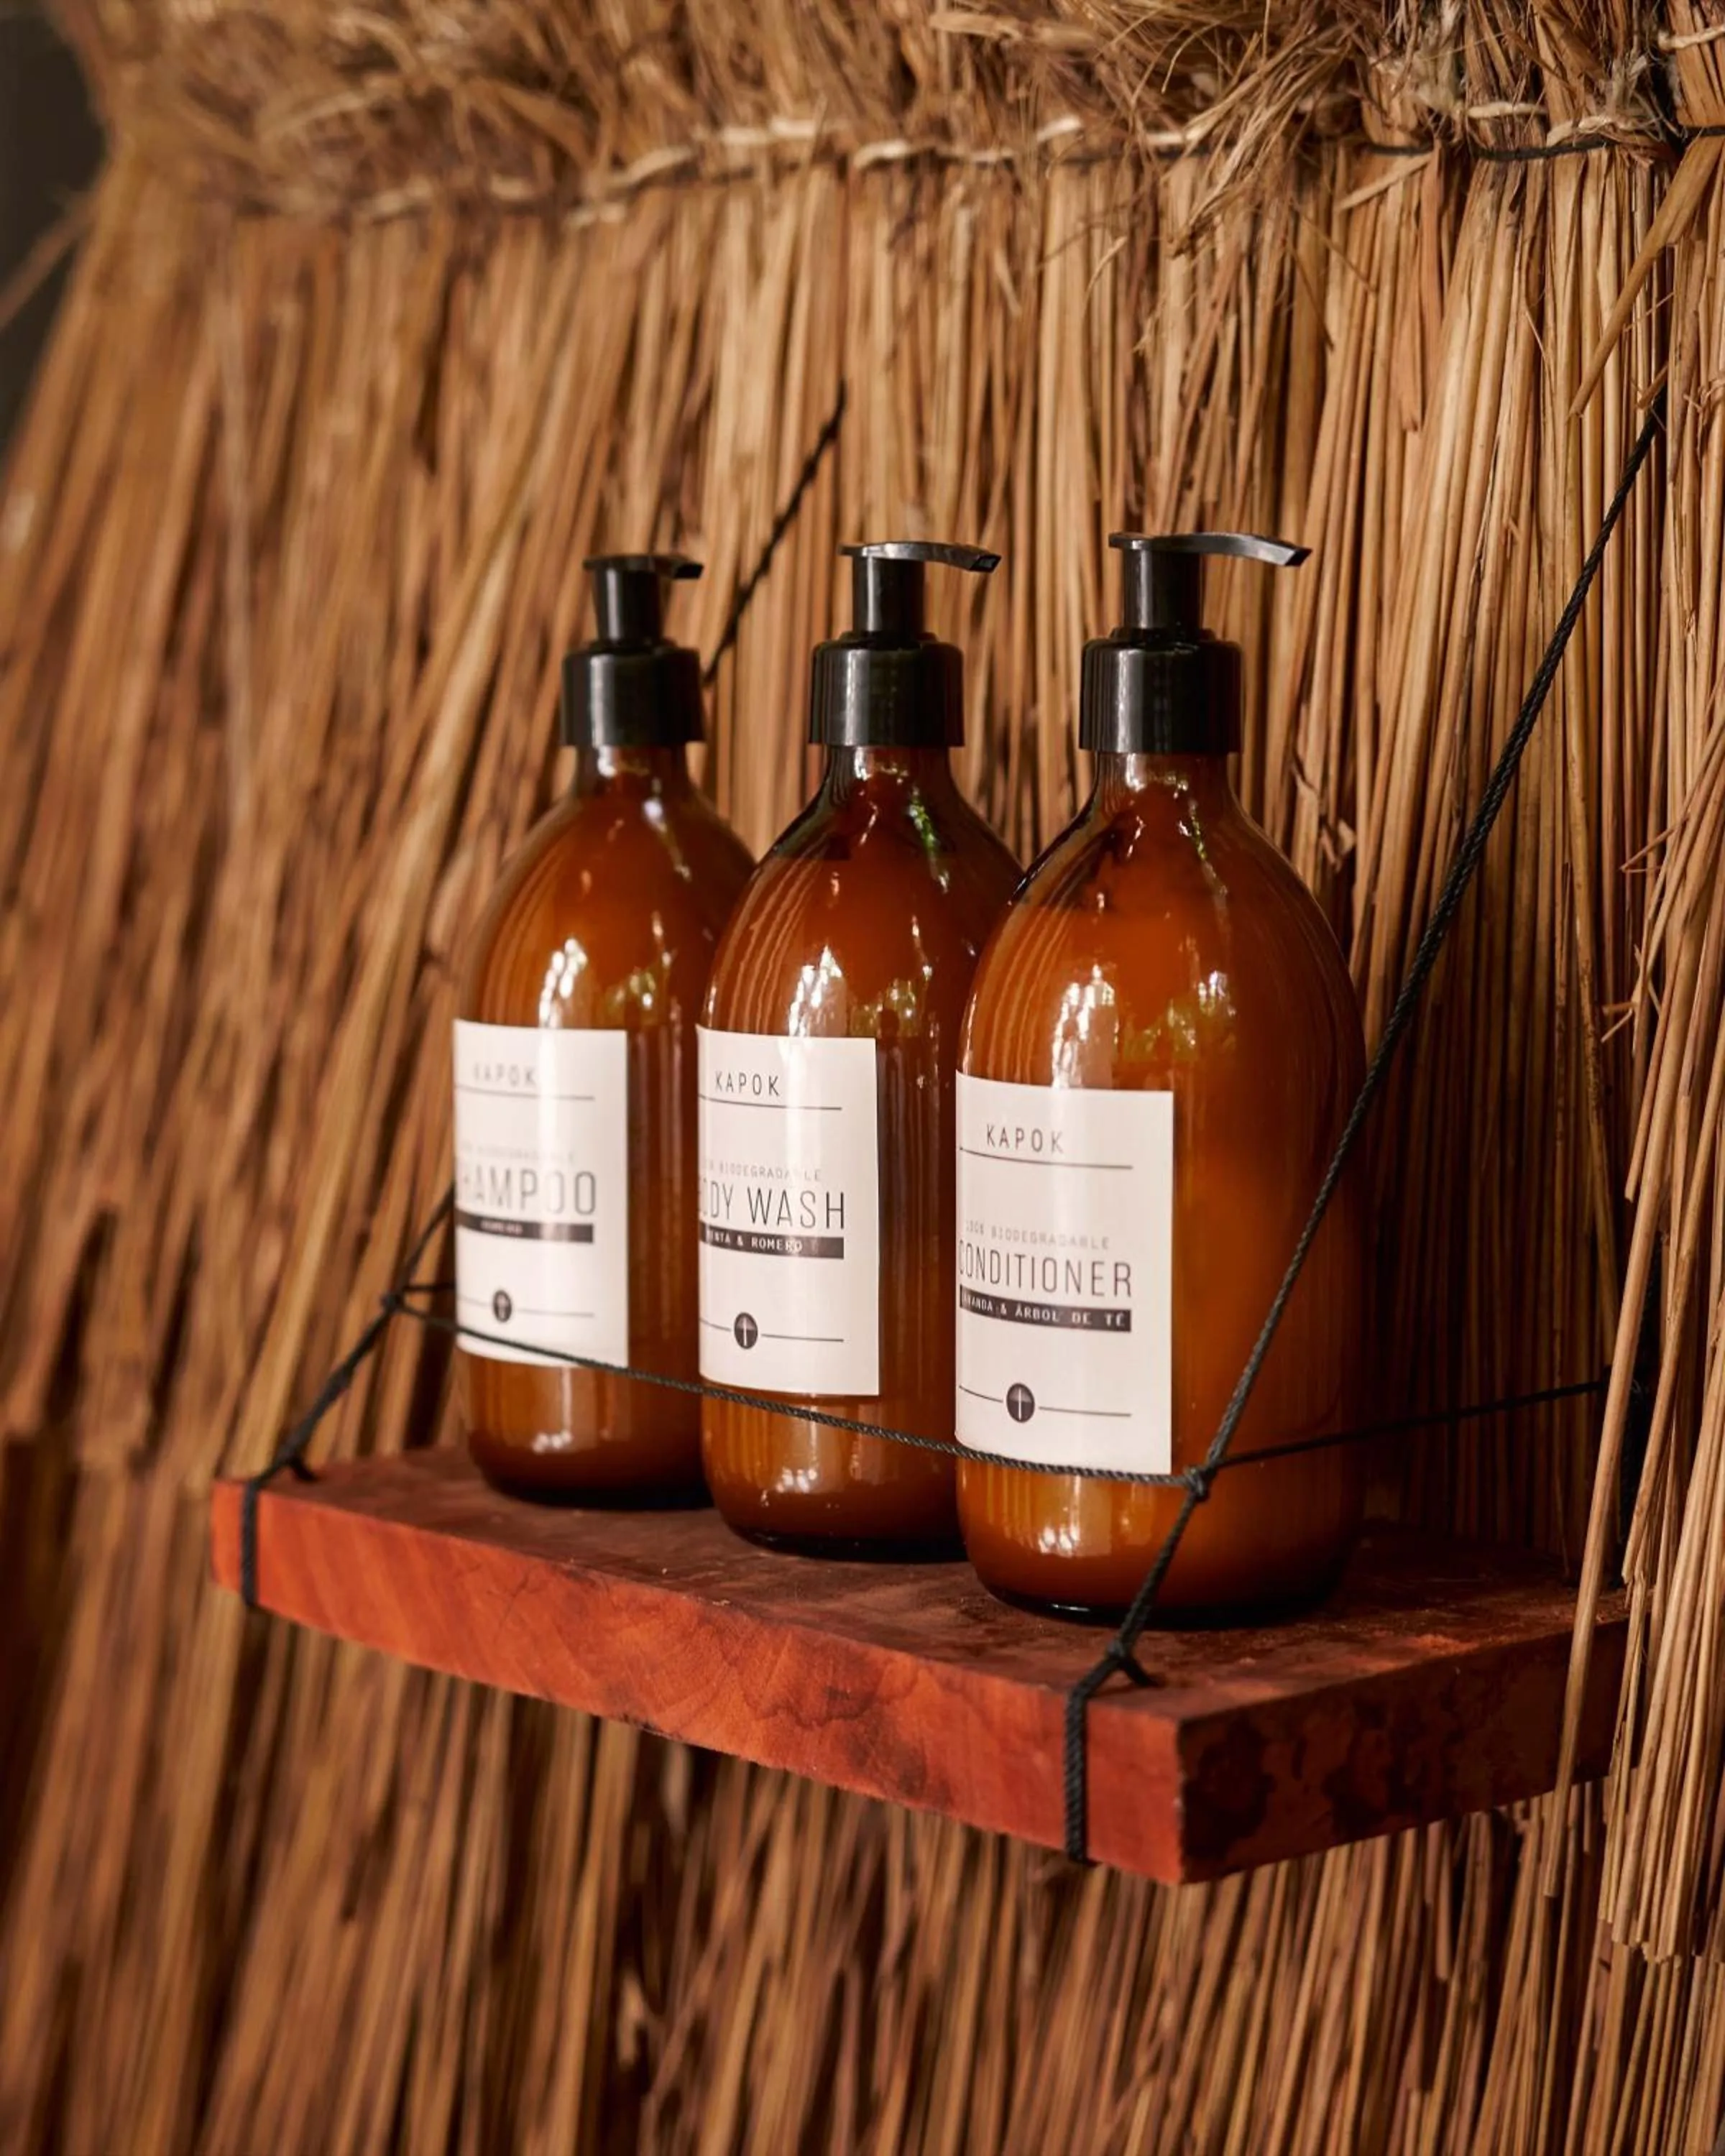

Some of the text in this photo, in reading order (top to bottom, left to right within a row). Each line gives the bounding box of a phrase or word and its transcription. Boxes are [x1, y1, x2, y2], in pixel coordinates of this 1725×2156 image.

[714, 1070, 780, 1096] KAPOK
[986, 1123, 1064, 1154] KAPOK
[747, 1186, 844, 1230] WASH
[751, 1236, 804, 1253] ROMERO
[959, 1240, 1131, 1297] CONDITIONER
[1072, 1312, 1093, 1326] DE
